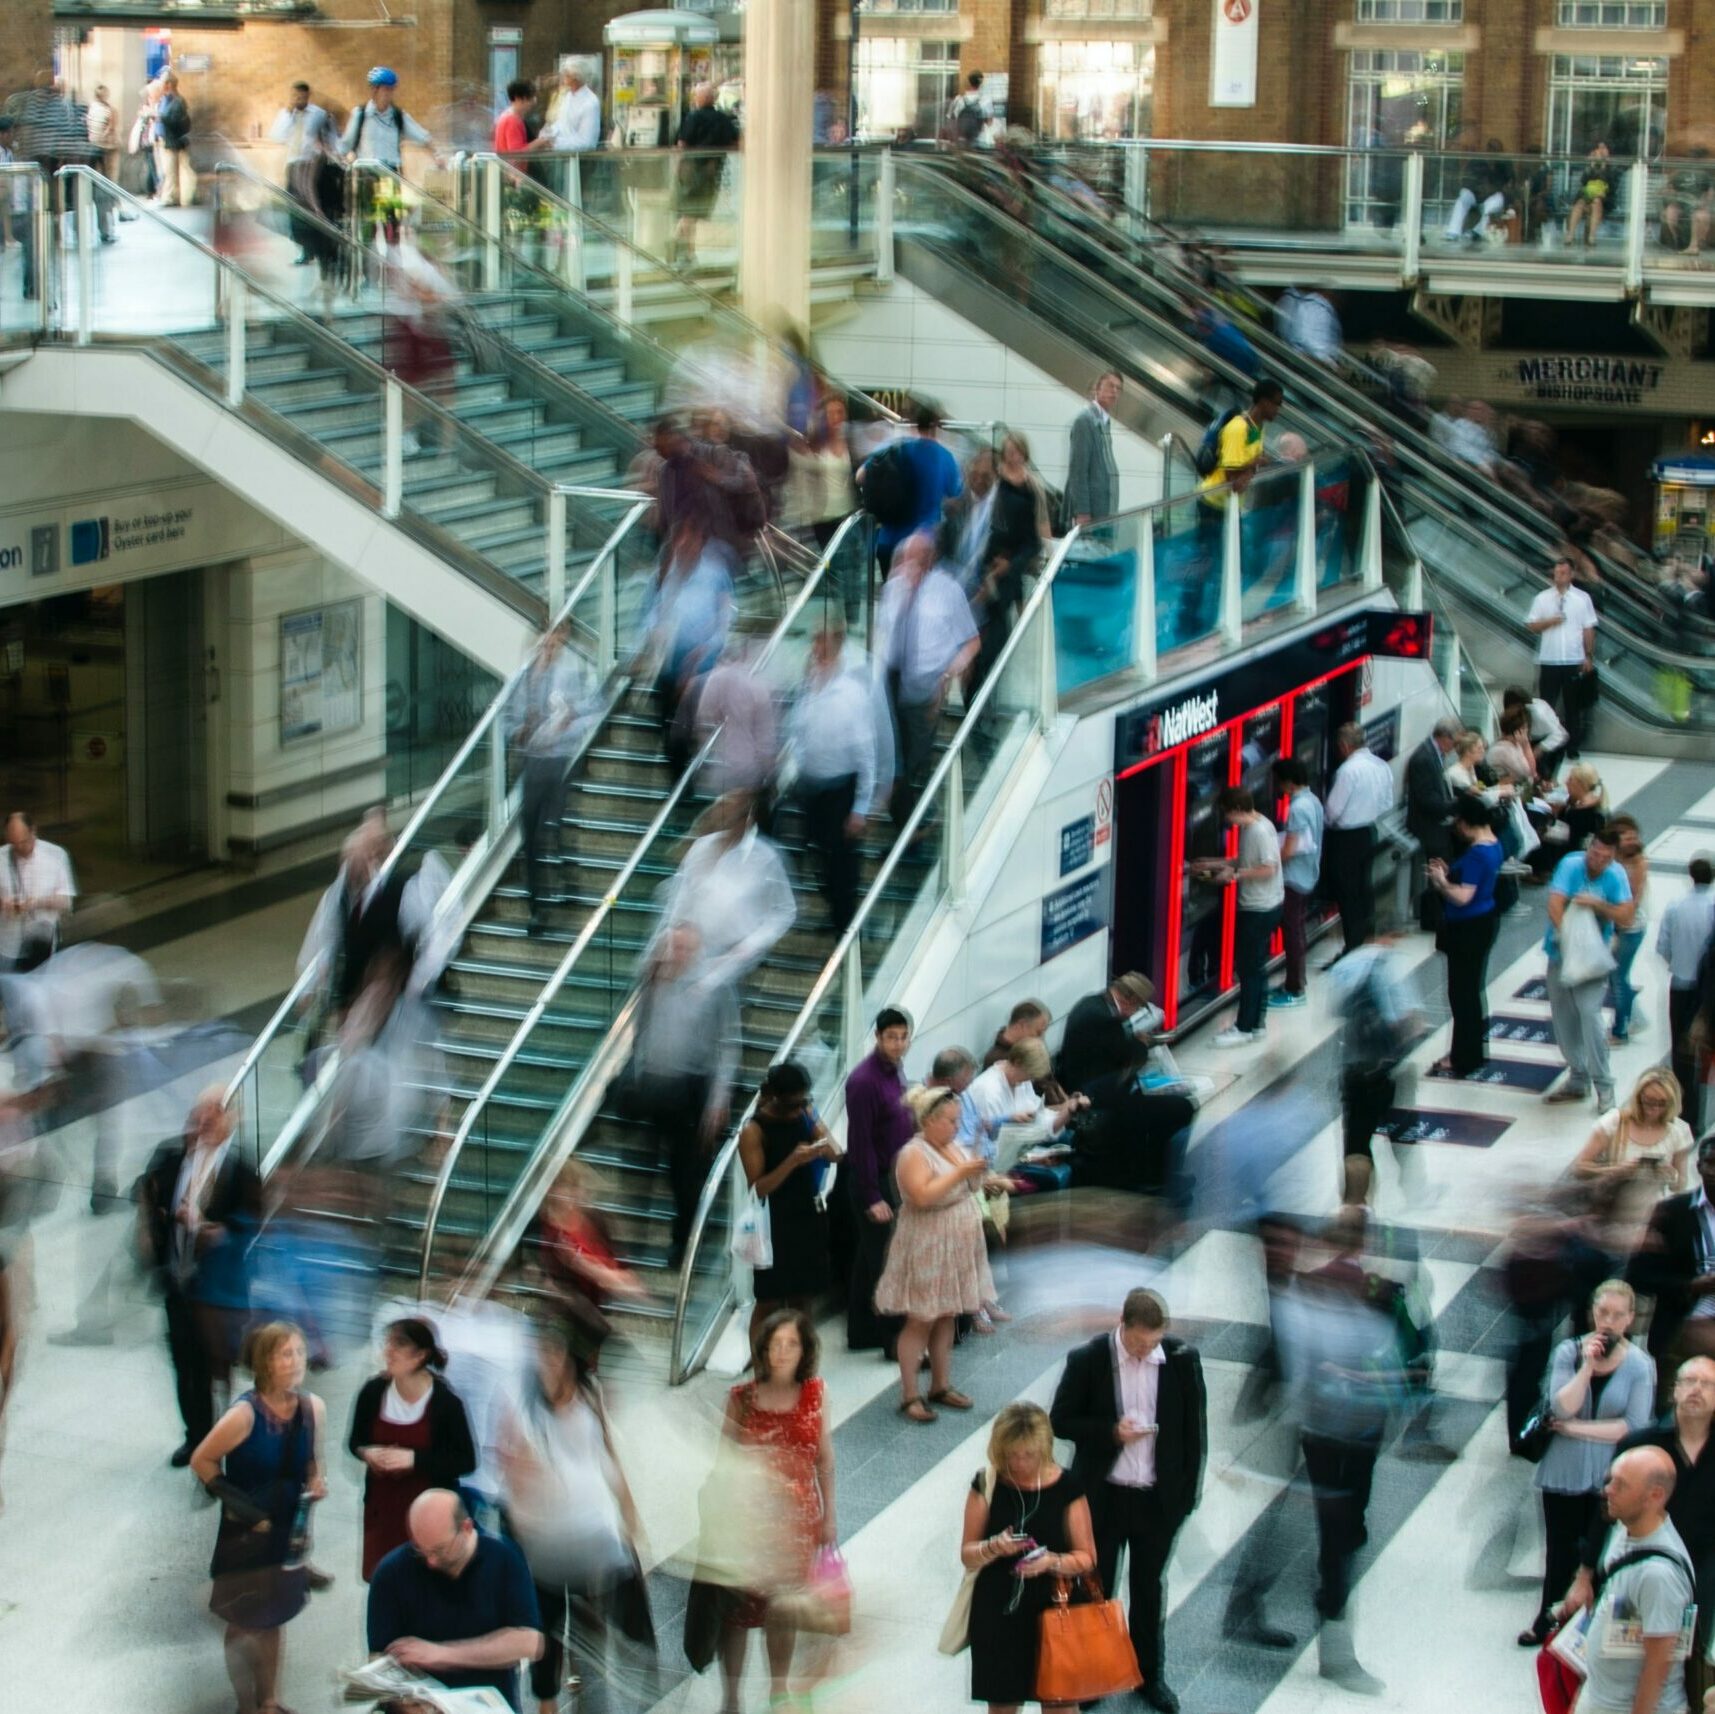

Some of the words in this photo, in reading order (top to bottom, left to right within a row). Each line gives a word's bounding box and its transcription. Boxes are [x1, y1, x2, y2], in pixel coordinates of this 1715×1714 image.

[1519, 355, 1664, 388] MERCHANT
[1536, 385, 1643, 403] BISHOPSGATE
[1163, 688, 1219, 749] NatWest
